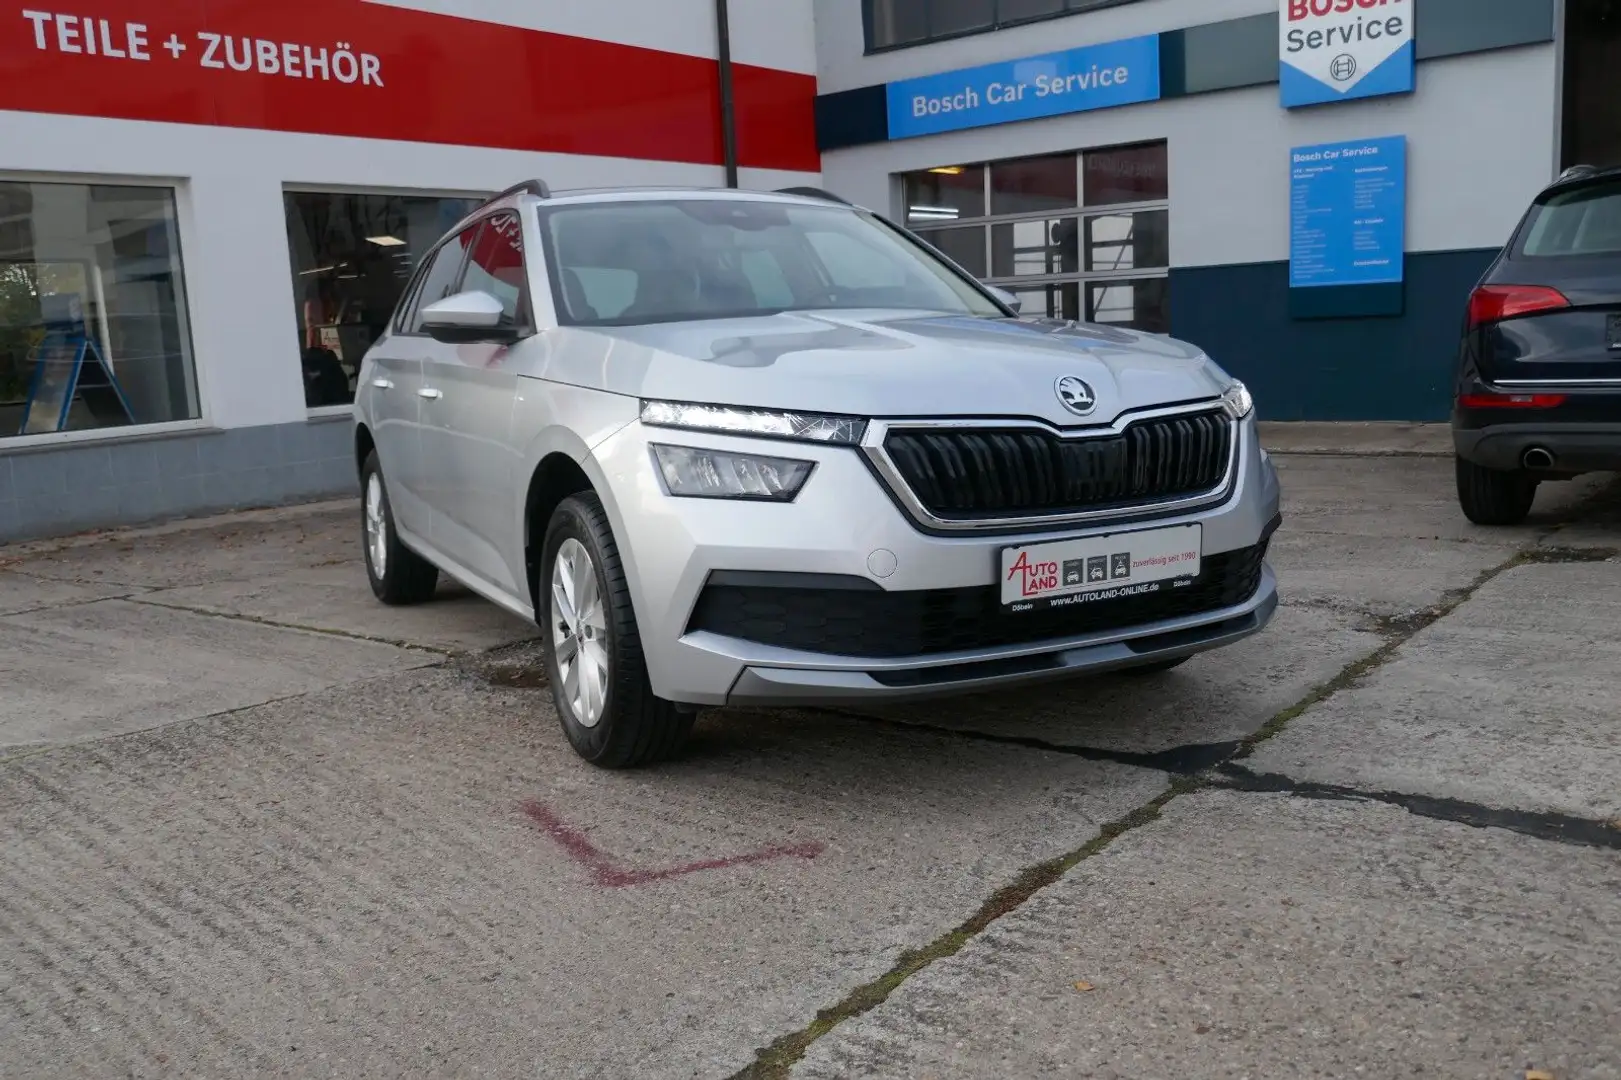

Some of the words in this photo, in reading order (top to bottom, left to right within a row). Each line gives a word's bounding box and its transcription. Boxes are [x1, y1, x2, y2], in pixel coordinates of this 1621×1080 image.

[1288, 0, 1404, 21] BOS
[1286, 16, 1403, 52] Service
[22, 9, 151, 61] TEILE
[163, 33, 187, 59] +
[197, 31, 385, 87] ZUBEHÖR
[912, 86, 979, 117] Bosch
[986, 79, 1027, 105] Car
[1035, 64, 1129, 97] Service
[1293, 152, 1321, 163] Bosch
[1323, 150, 1339, 160] Car
[1342, 146, 1378, 157] Service
[1007, 552, 1058, 580] AUTO
[1132, 556, 1167, 569] zuverlässig
[1168, 554, 1179, 563] seit
[1050, 583, 1159, 607] www.AUTOLAND-ONLINE.de
